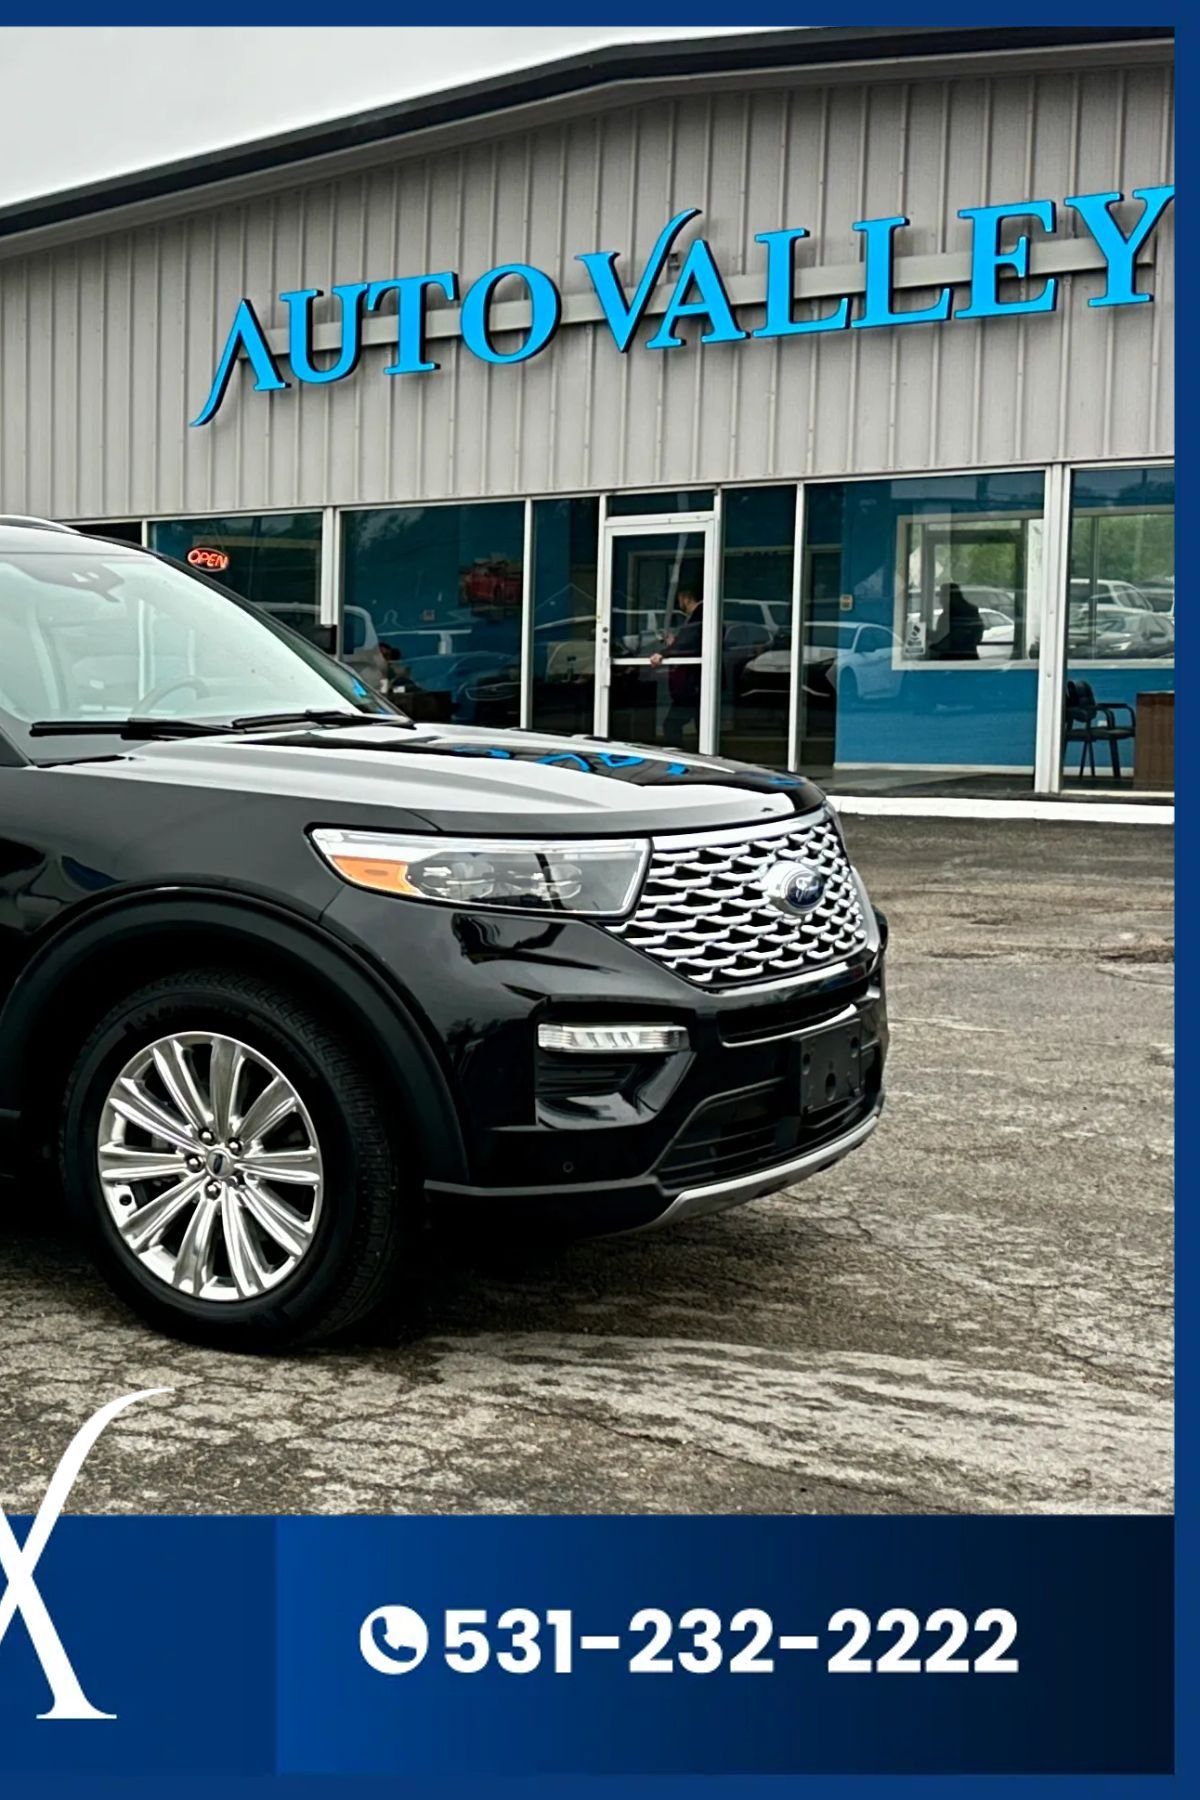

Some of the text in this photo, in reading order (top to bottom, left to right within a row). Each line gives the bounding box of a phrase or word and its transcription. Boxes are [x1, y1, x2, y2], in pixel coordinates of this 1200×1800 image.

[189, 184, 1175, 427] AUTO VALLEY
[188, 548, 229, 571] OPEN
